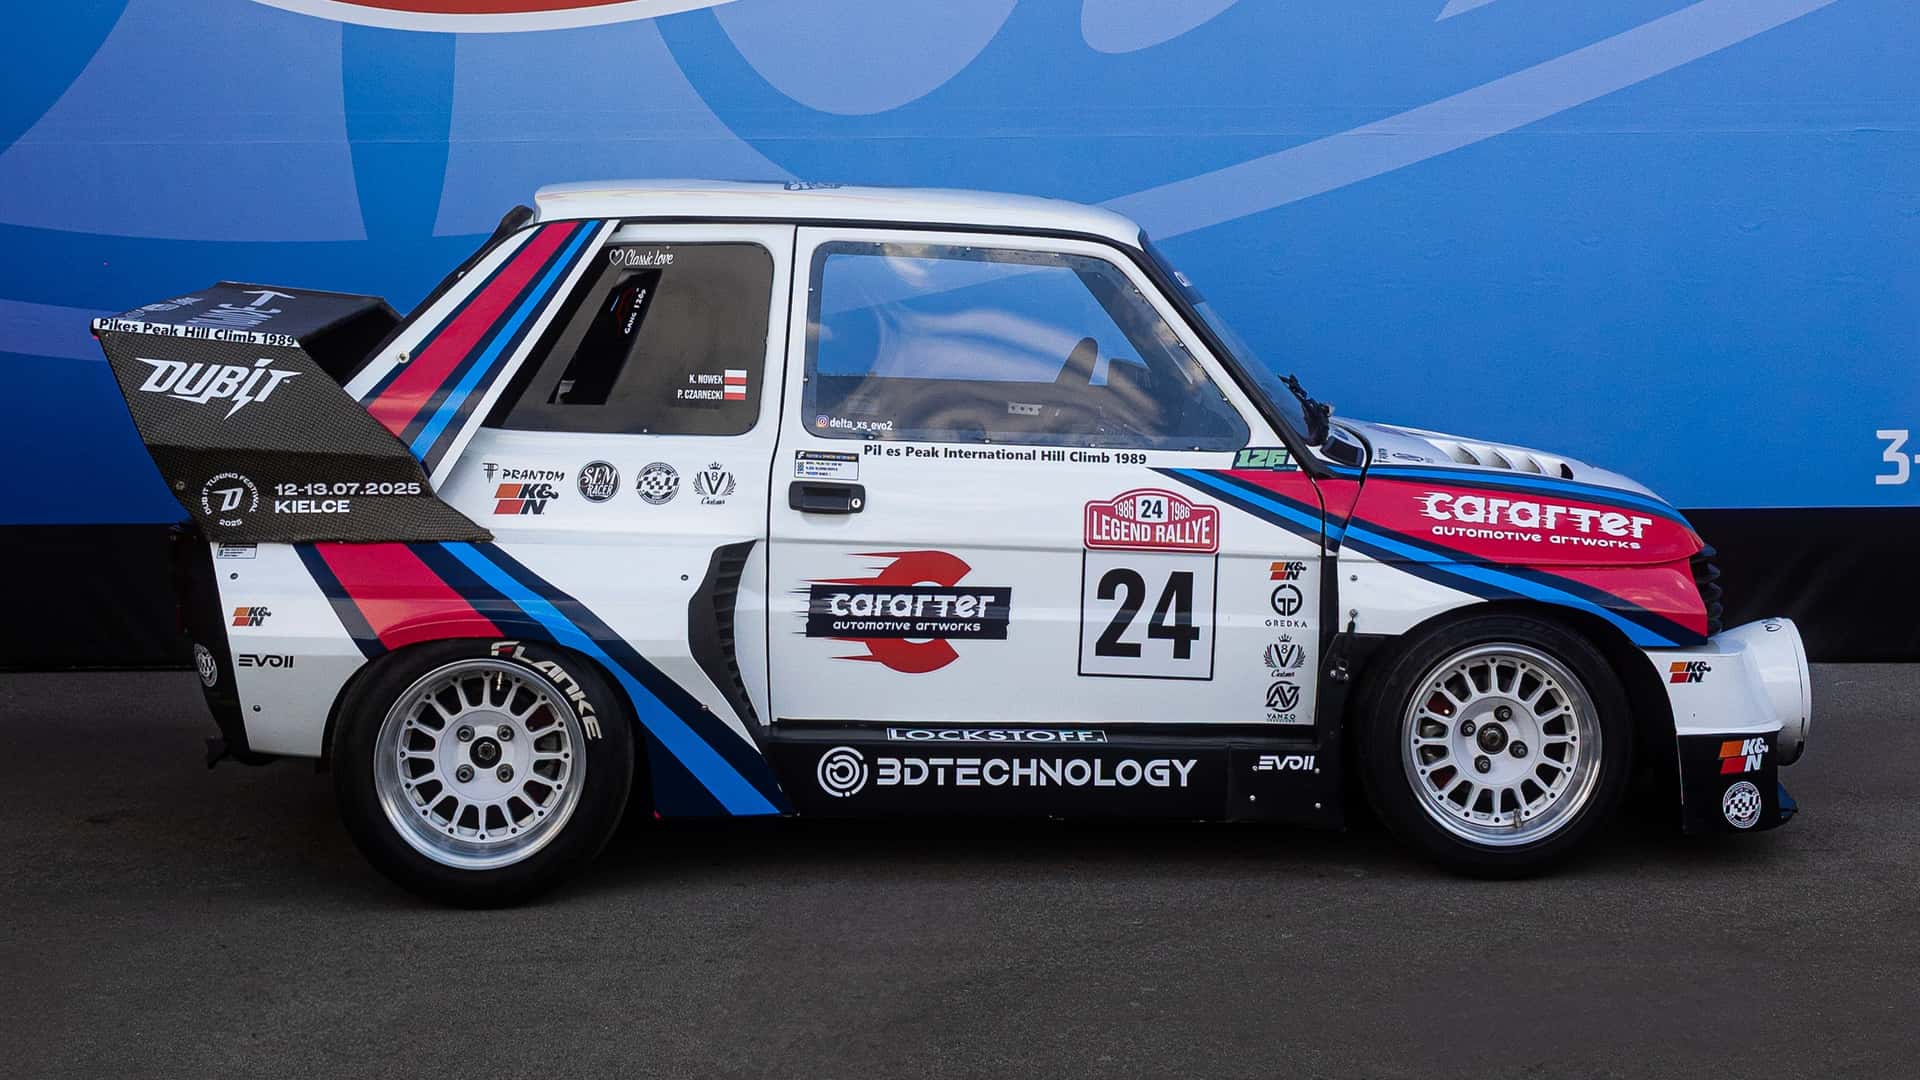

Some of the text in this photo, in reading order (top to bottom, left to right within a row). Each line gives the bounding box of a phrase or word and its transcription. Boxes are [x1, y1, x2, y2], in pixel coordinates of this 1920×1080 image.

[624, 249, 674, 266] Classic Love
[99, 318, 295, 346] Pikes Peak Hill Climb 1989
[689, 374, 723, 384] K. NOWEK
[677, 389, 723, 400] P. CZARNECKI
[830, 417, 893, 432] delta_xs_evo2
[906, 446, 939, 458] Peak
[944, 447, 1037, 461] International
[1041, 450, 1065, 462] Hill
[1070, 451, 1110, 464] Climb
[1114, 453, 1147, 465] 1989
[1235, 449, 1288, 467] 126
[502, 468, 565, 481] PRANTOM
[201, 472, 259, 515] DUB IT TUNING FESTIVAL
[274, 482, 421, 496] 12-13.07.2025
[274, 500, 350, 514] KIELCE
[1114, 499, 1191, 521] 1986 24 1986
[219, 518, 243, 527] 2025
[1092, 510, 1211, 544] LEGEND RALLYE
[1432, 525, 1641, 550] automotive artworks
[1095, 567, 1200, 660] 24
[833, 621, 981, 632] automotive artworks
[1264, 619, 1308, 628] GREDKA
[877, 758, 1197, 787] 3DTECHNOLOGY
